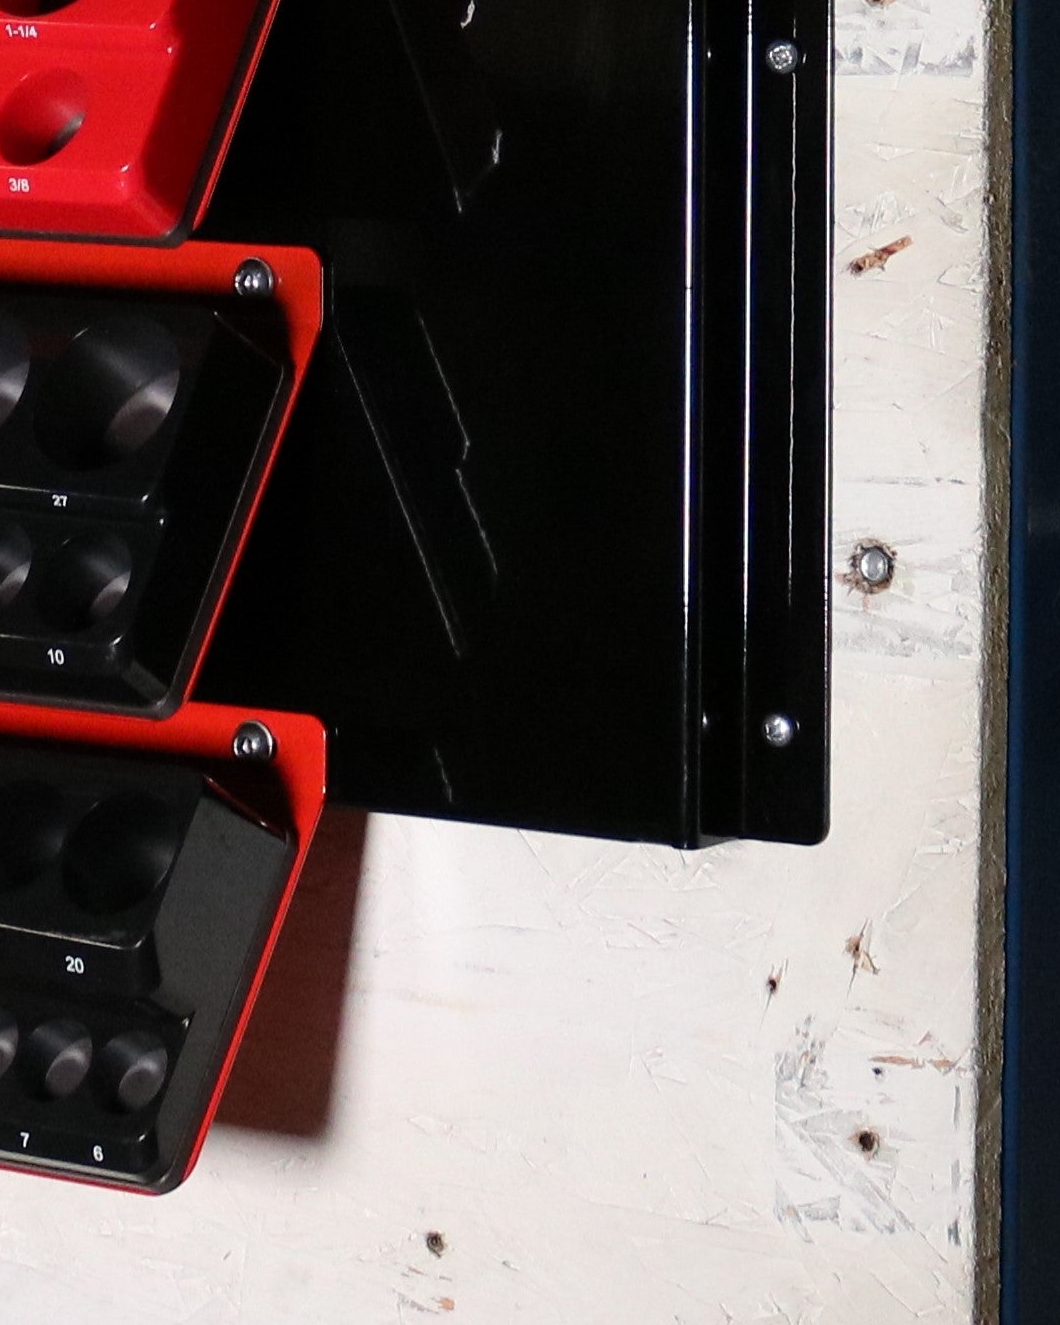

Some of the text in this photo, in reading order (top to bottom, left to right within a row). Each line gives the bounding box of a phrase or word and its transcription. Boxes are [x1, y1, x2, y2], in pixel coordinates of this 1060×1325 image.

[5, 24, 38, 38] 1-1/4
[8, 177, 30, 193] 3/8
[51, 494, 68, 507] 27
[47, 648, 65, 665] 10
[65, 955, 85, 974] 20
[20, 1131, 30, 1148] 7
[93, 1145, 104, 1162] 6
